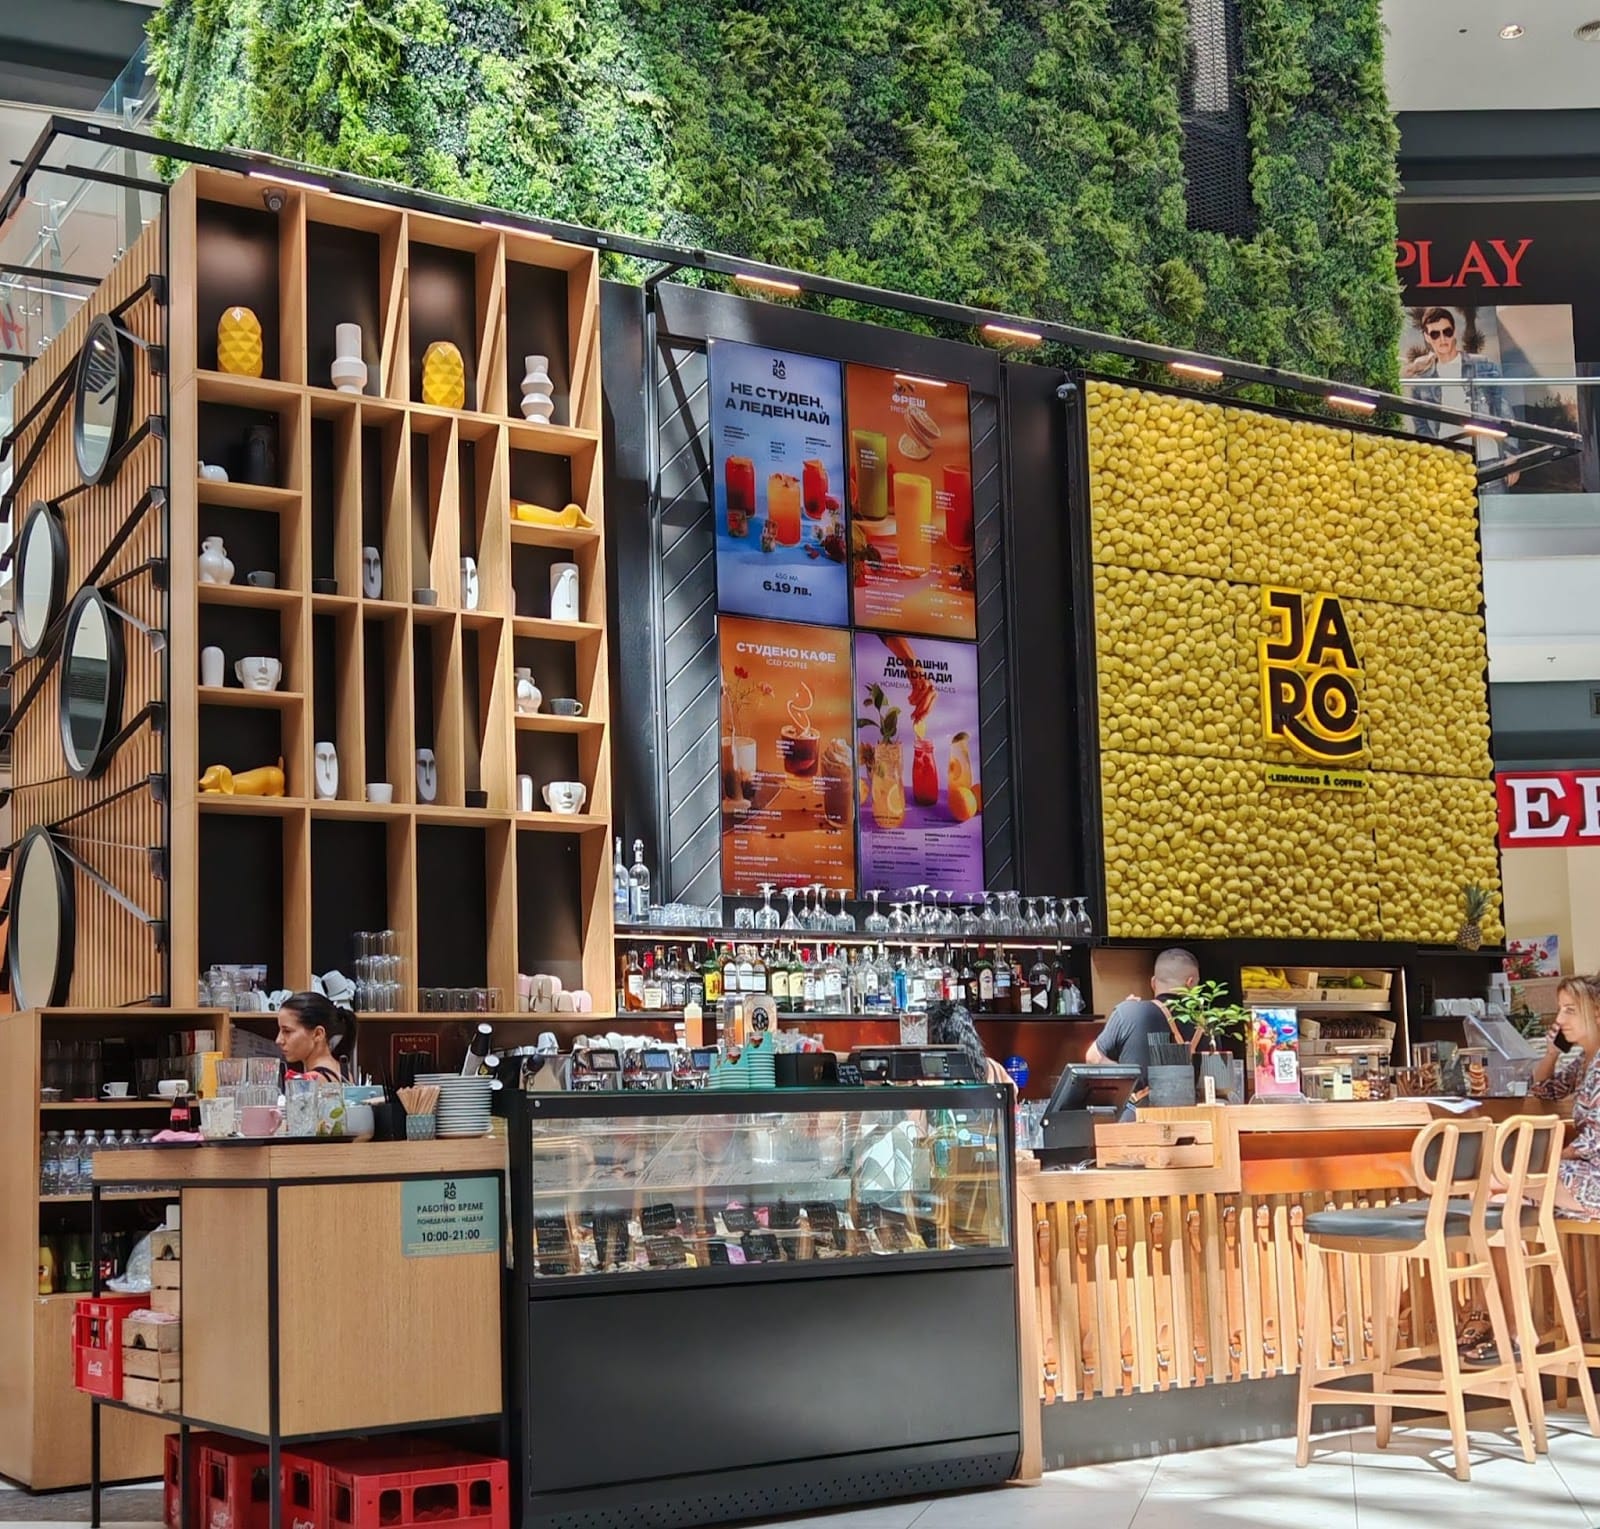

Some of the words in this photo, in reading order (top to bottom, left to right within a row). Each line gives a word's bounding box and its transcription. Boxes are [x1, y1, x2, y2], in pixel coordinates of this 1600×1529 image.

[730, 381, 753, 396] НЕ
[755, 386, 824, 410] СТУДЕН,
[891, 393, 926, 409] ФРЕШ
[725, 397, 737, 410] А
[739, 399, 795, 420] ЛЕДЕН
[797, 410, 831, 426] ЧАЙ
[762, 580, 791, 593] 6.19
[793, 585, 812, 597] лв.
[736, 642, 799, 658] СТУДЕНО
[800, 649, 836, 663] КАФЕ
[886, 656, 949, 671] ДОМАШНИ
[883, 667, 953, 684] ЛИМОНАДИ
[1323, 774, 1331, 786] &
[416, 1203, 456, 1213] РАБОТНО
[458, 1202, 484, 1211] ВРЕМЕ
[421, 1229, 480, 1242] 10:00-21:00
